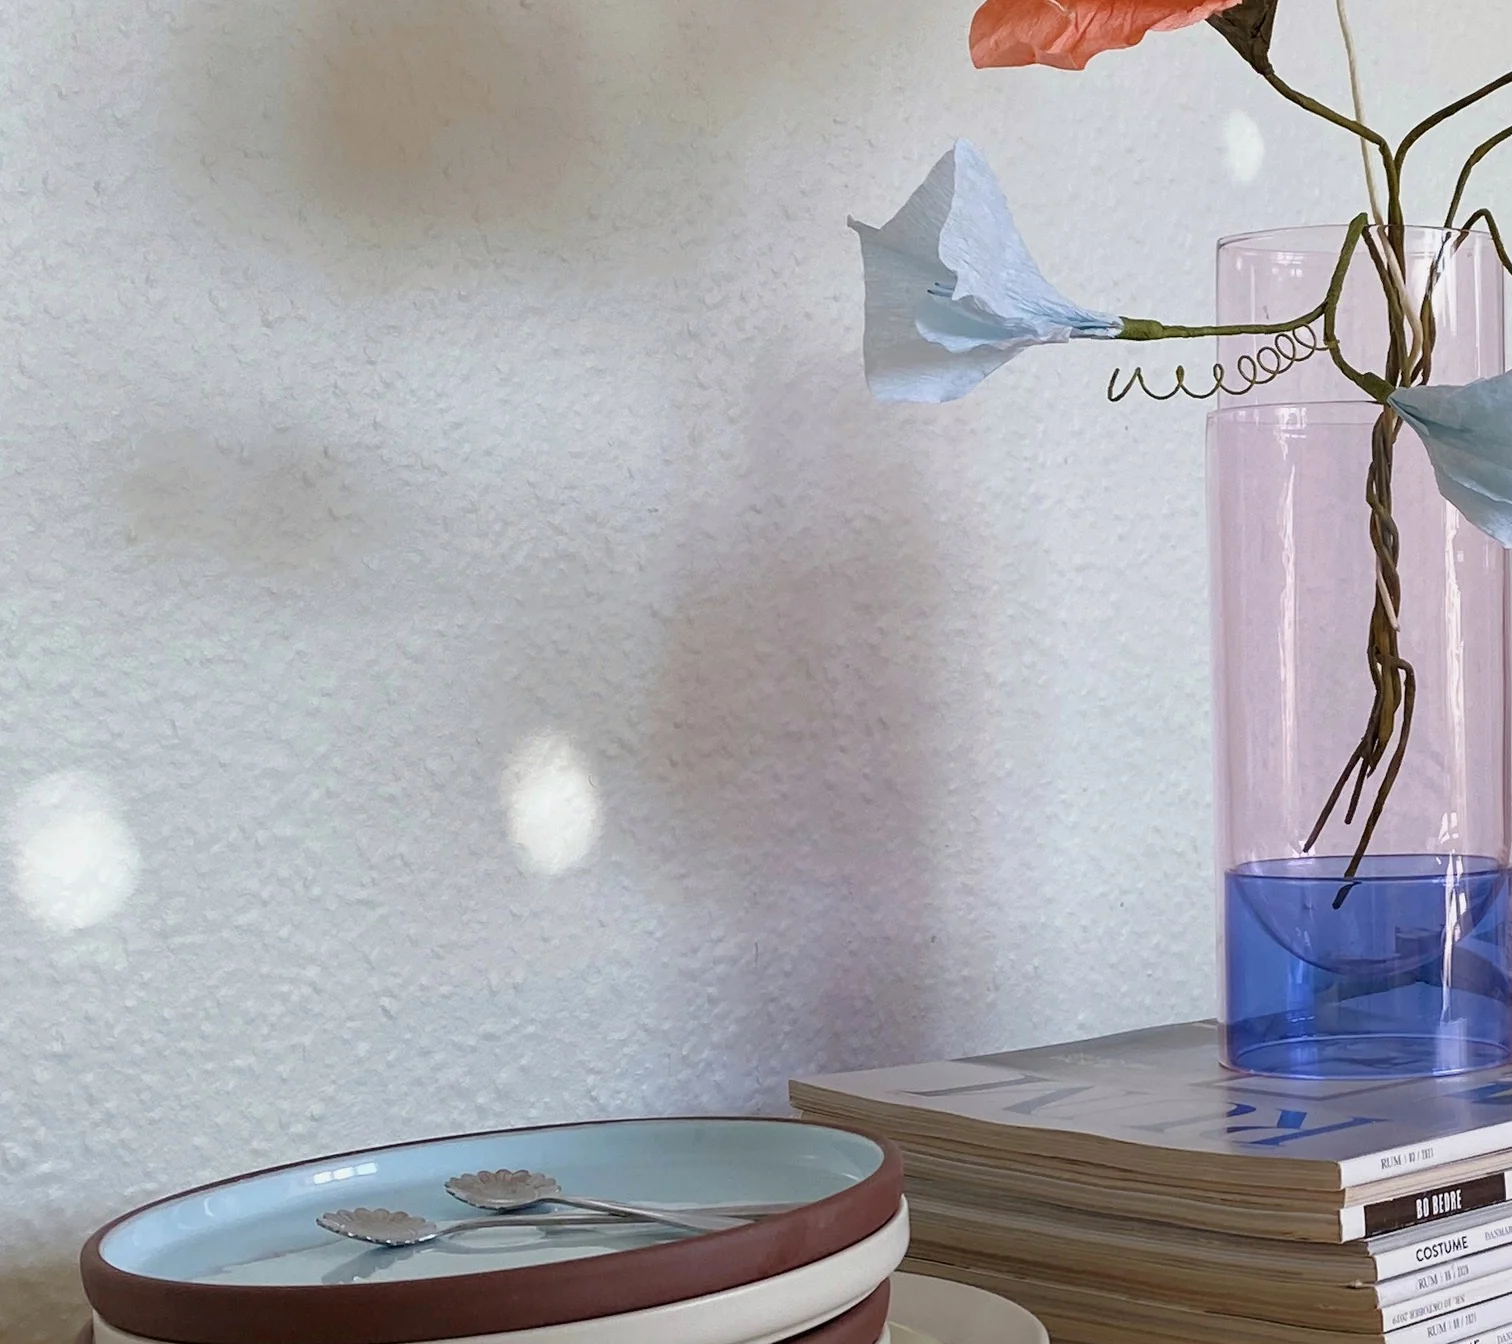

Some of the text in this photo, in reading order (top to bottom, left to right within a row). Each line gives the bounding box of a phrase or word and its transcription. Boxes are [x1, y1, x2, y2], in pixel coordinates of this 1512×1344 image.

[1381, 1154, 1402, 1170] RUM
[1416, 1189, 1462, 1219] BO BEDRE
[1416, 1236, 1469, 1262] COSTUME
[1417, 1275, 1438, 1290] RUM
[1427, 1322, 1447, 1338] RUM
